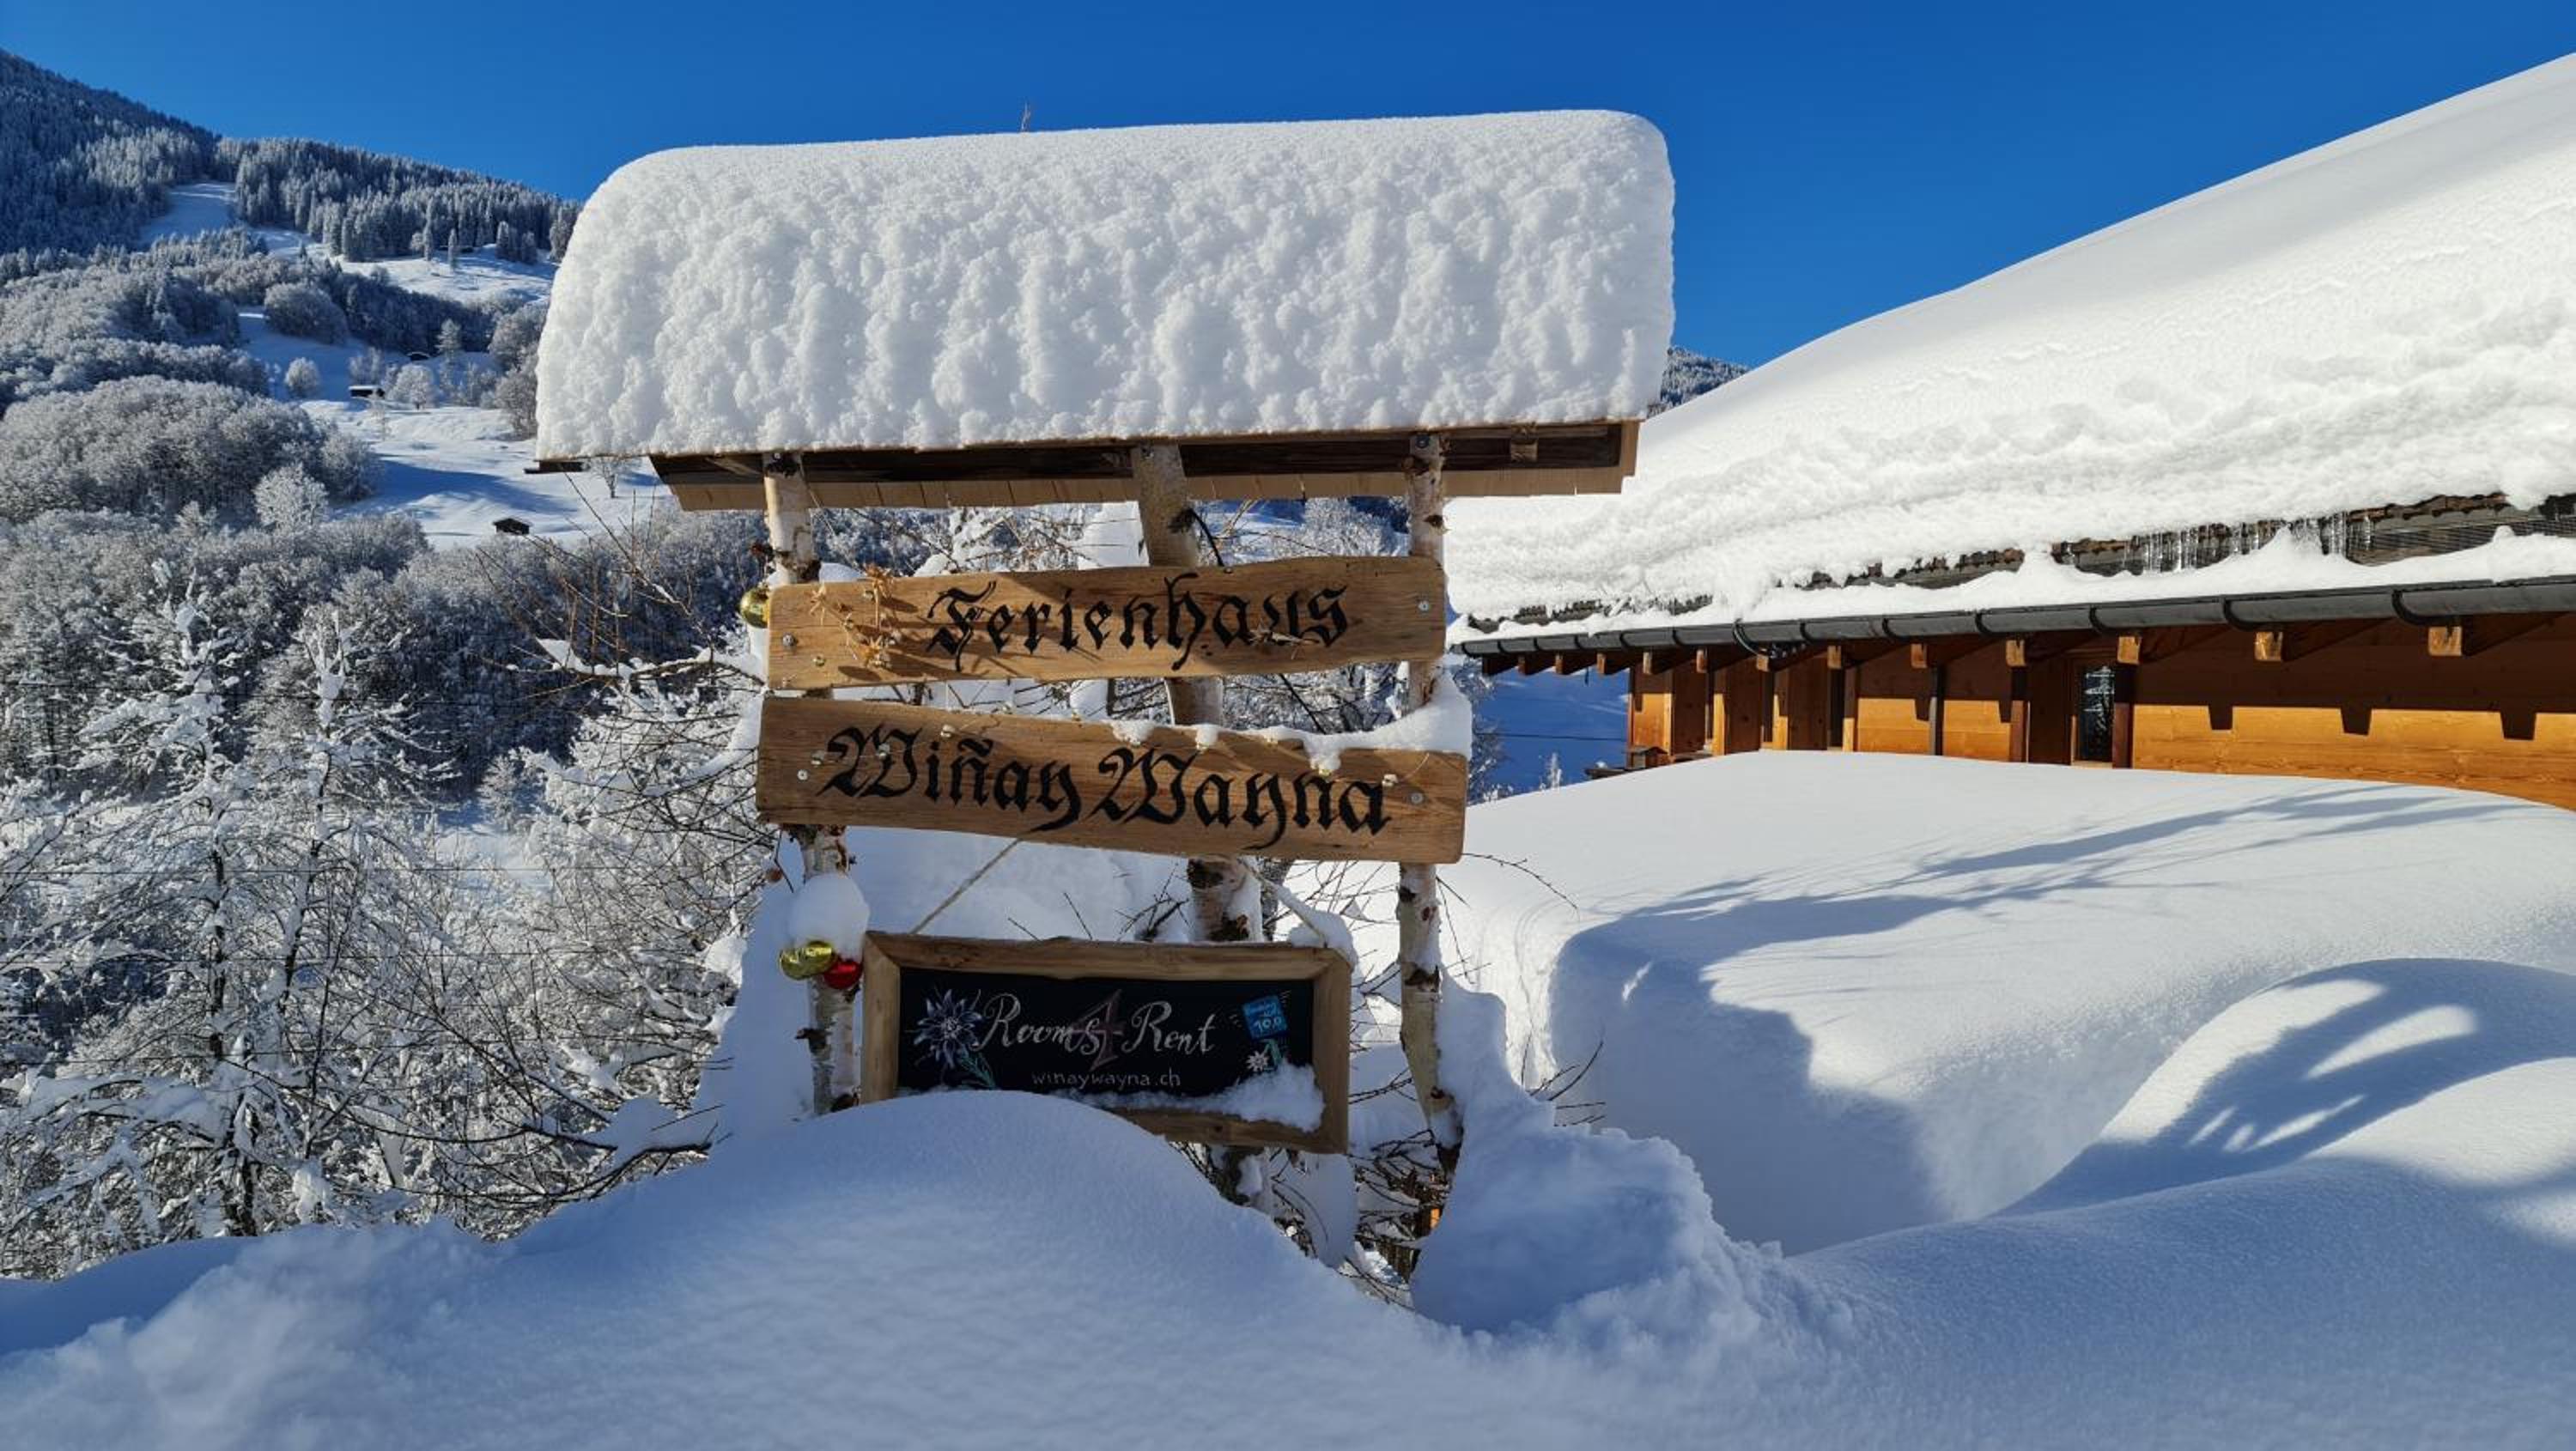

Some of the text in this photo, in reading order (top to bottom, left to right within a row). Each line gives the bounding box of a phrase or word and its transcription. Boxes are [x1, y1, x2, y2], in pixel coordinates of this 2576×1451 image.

[927, 573, 1347, 671] Ferienhaus
[816, 724, 1392, 850] Wiñay Wayna
[973, 992, 1100, 1056] Rooms
[1121, 1000, 1219, 1055] Rent
[1031, 1066, 1182, 1090] winaywayna.ch
